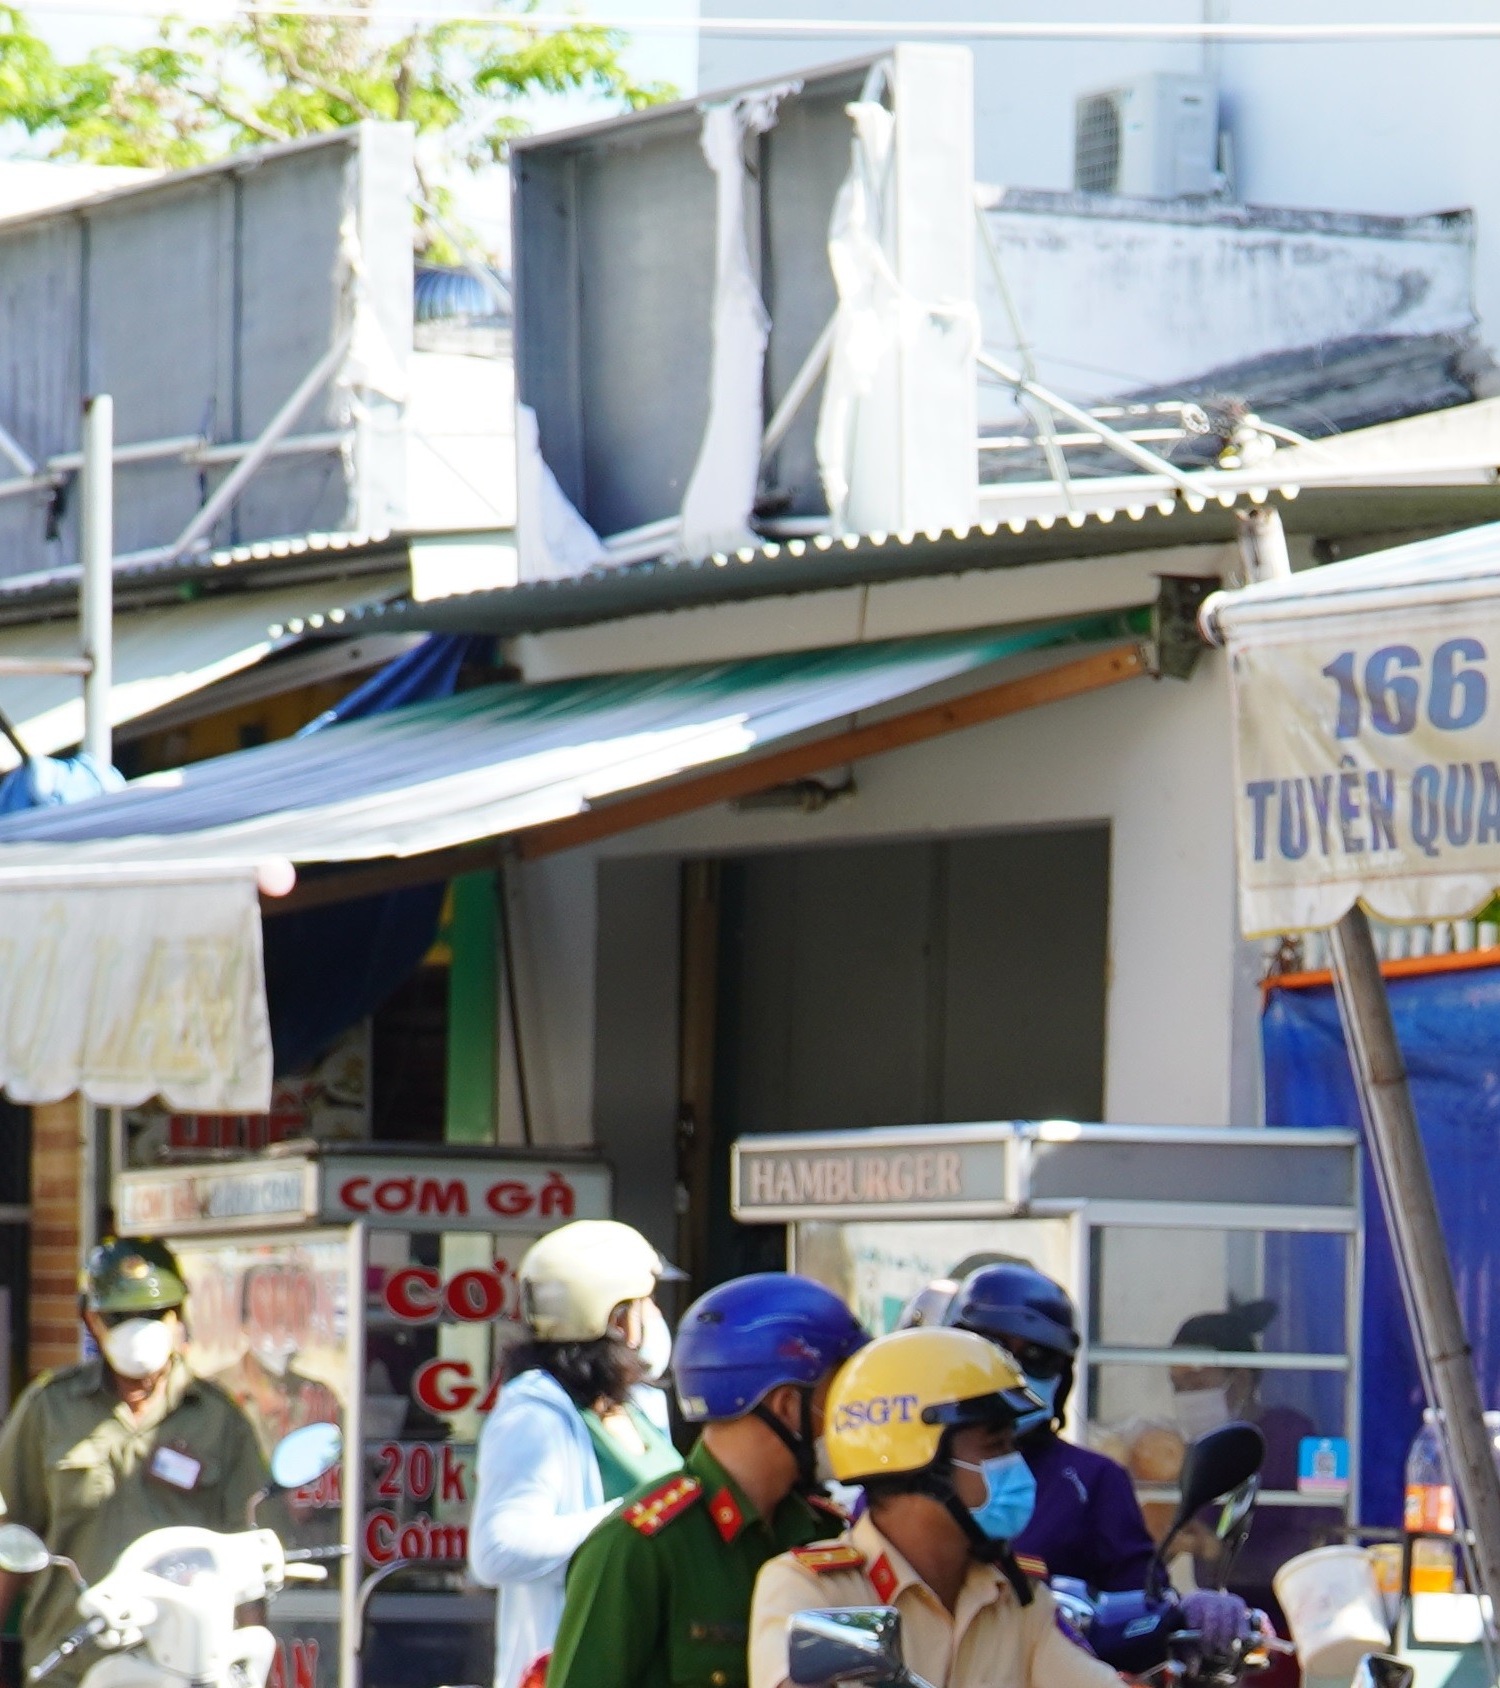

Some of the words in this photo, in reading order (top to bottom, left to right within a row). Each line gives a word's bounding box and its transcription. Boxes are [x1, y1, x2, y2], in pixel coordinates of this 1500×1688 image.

[1322, 637, 1490, 740] 166
[1246, 754, 1399, 863] TUYÊN
[340, 1174, 469, 1216] CƠM
[485, 1170, 576, 1217] GÀ
[750, 1150, 963, 1203] HAMBURGER
[386, 1259, 518, 1323] CƠ
[416, 1358, 503, 1415] G
[835, 1394, 919, 1435] CSGT
